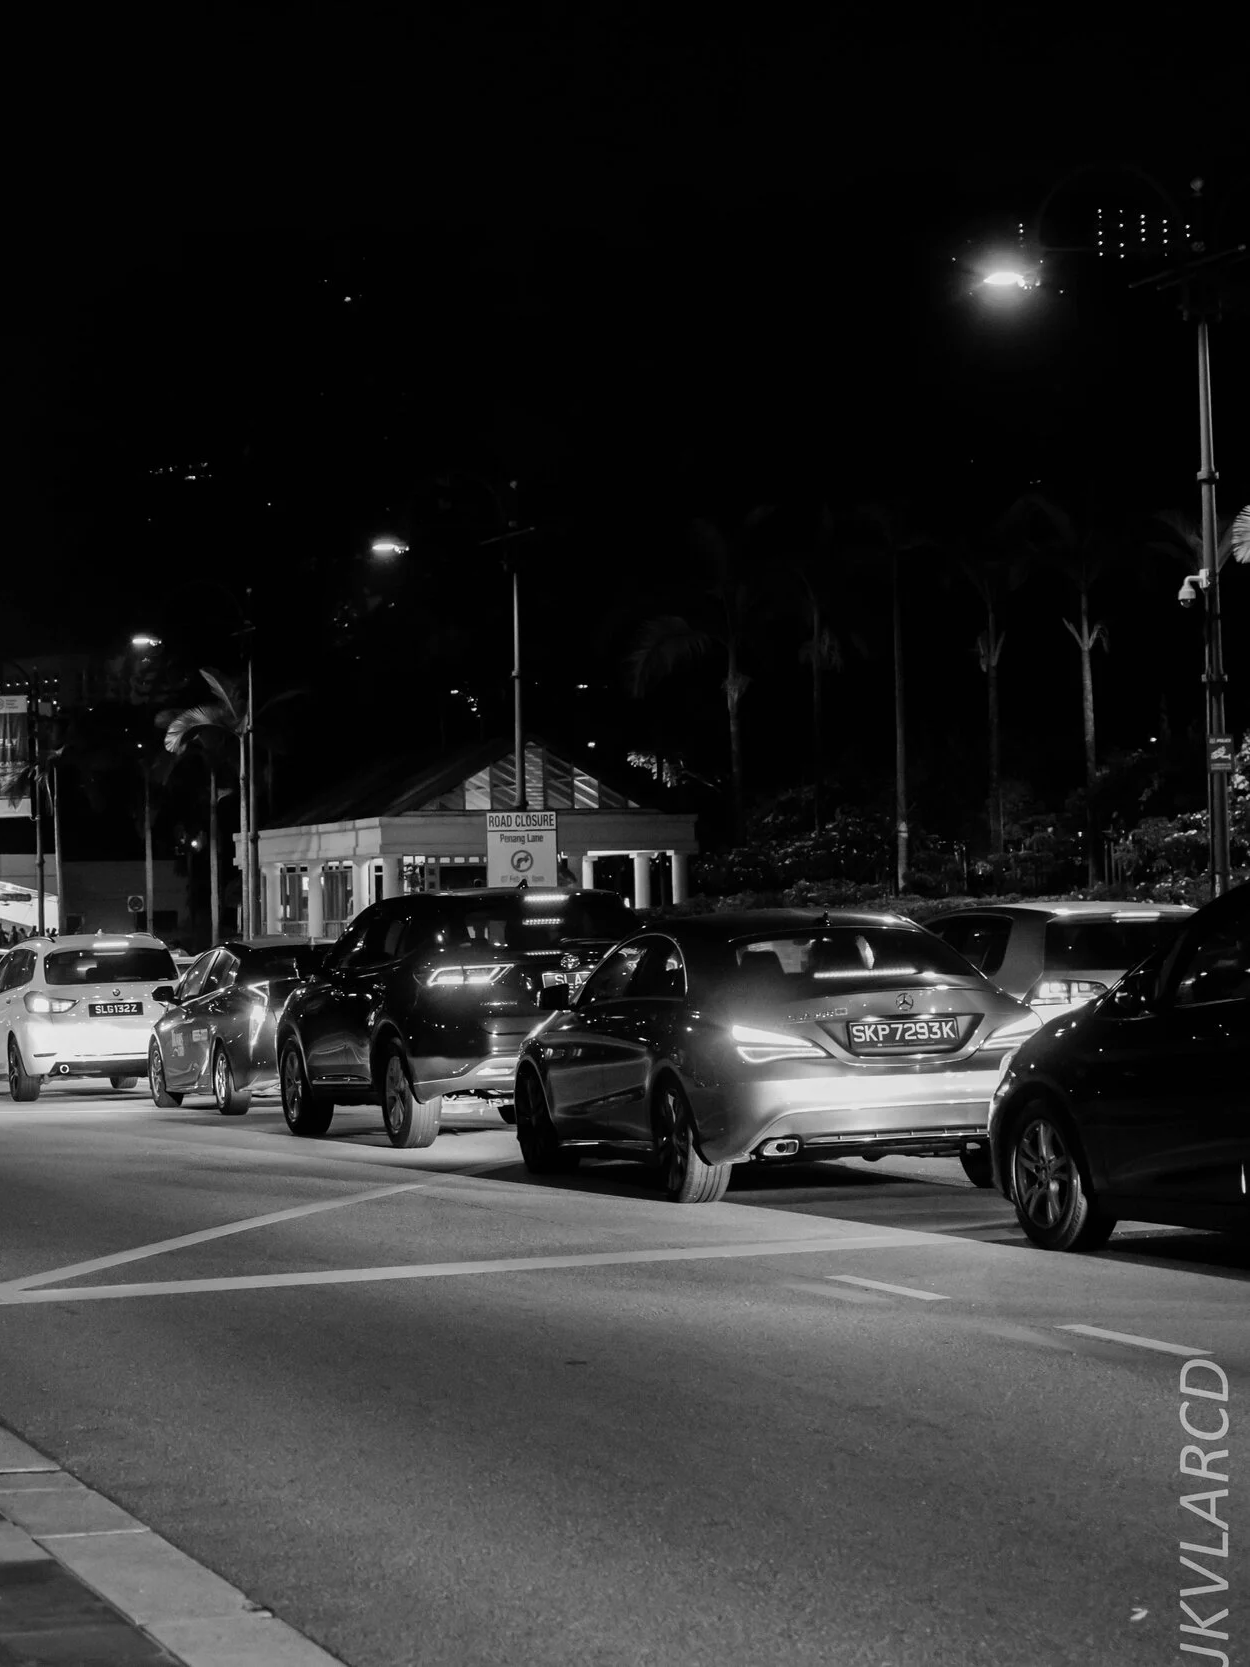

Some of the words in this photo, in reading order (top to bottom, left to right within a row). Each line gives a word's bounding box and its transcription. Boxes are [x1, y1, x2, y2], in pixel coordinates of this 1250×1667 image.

[488, 814, 512, 828] ROAD
[515, 813, 555, 828] CLOSURE
[499, 833, 526, 845] Penang
[527, 833, 544, 843] Lane
[94, 1003, 138, 1015] SLG132Z
